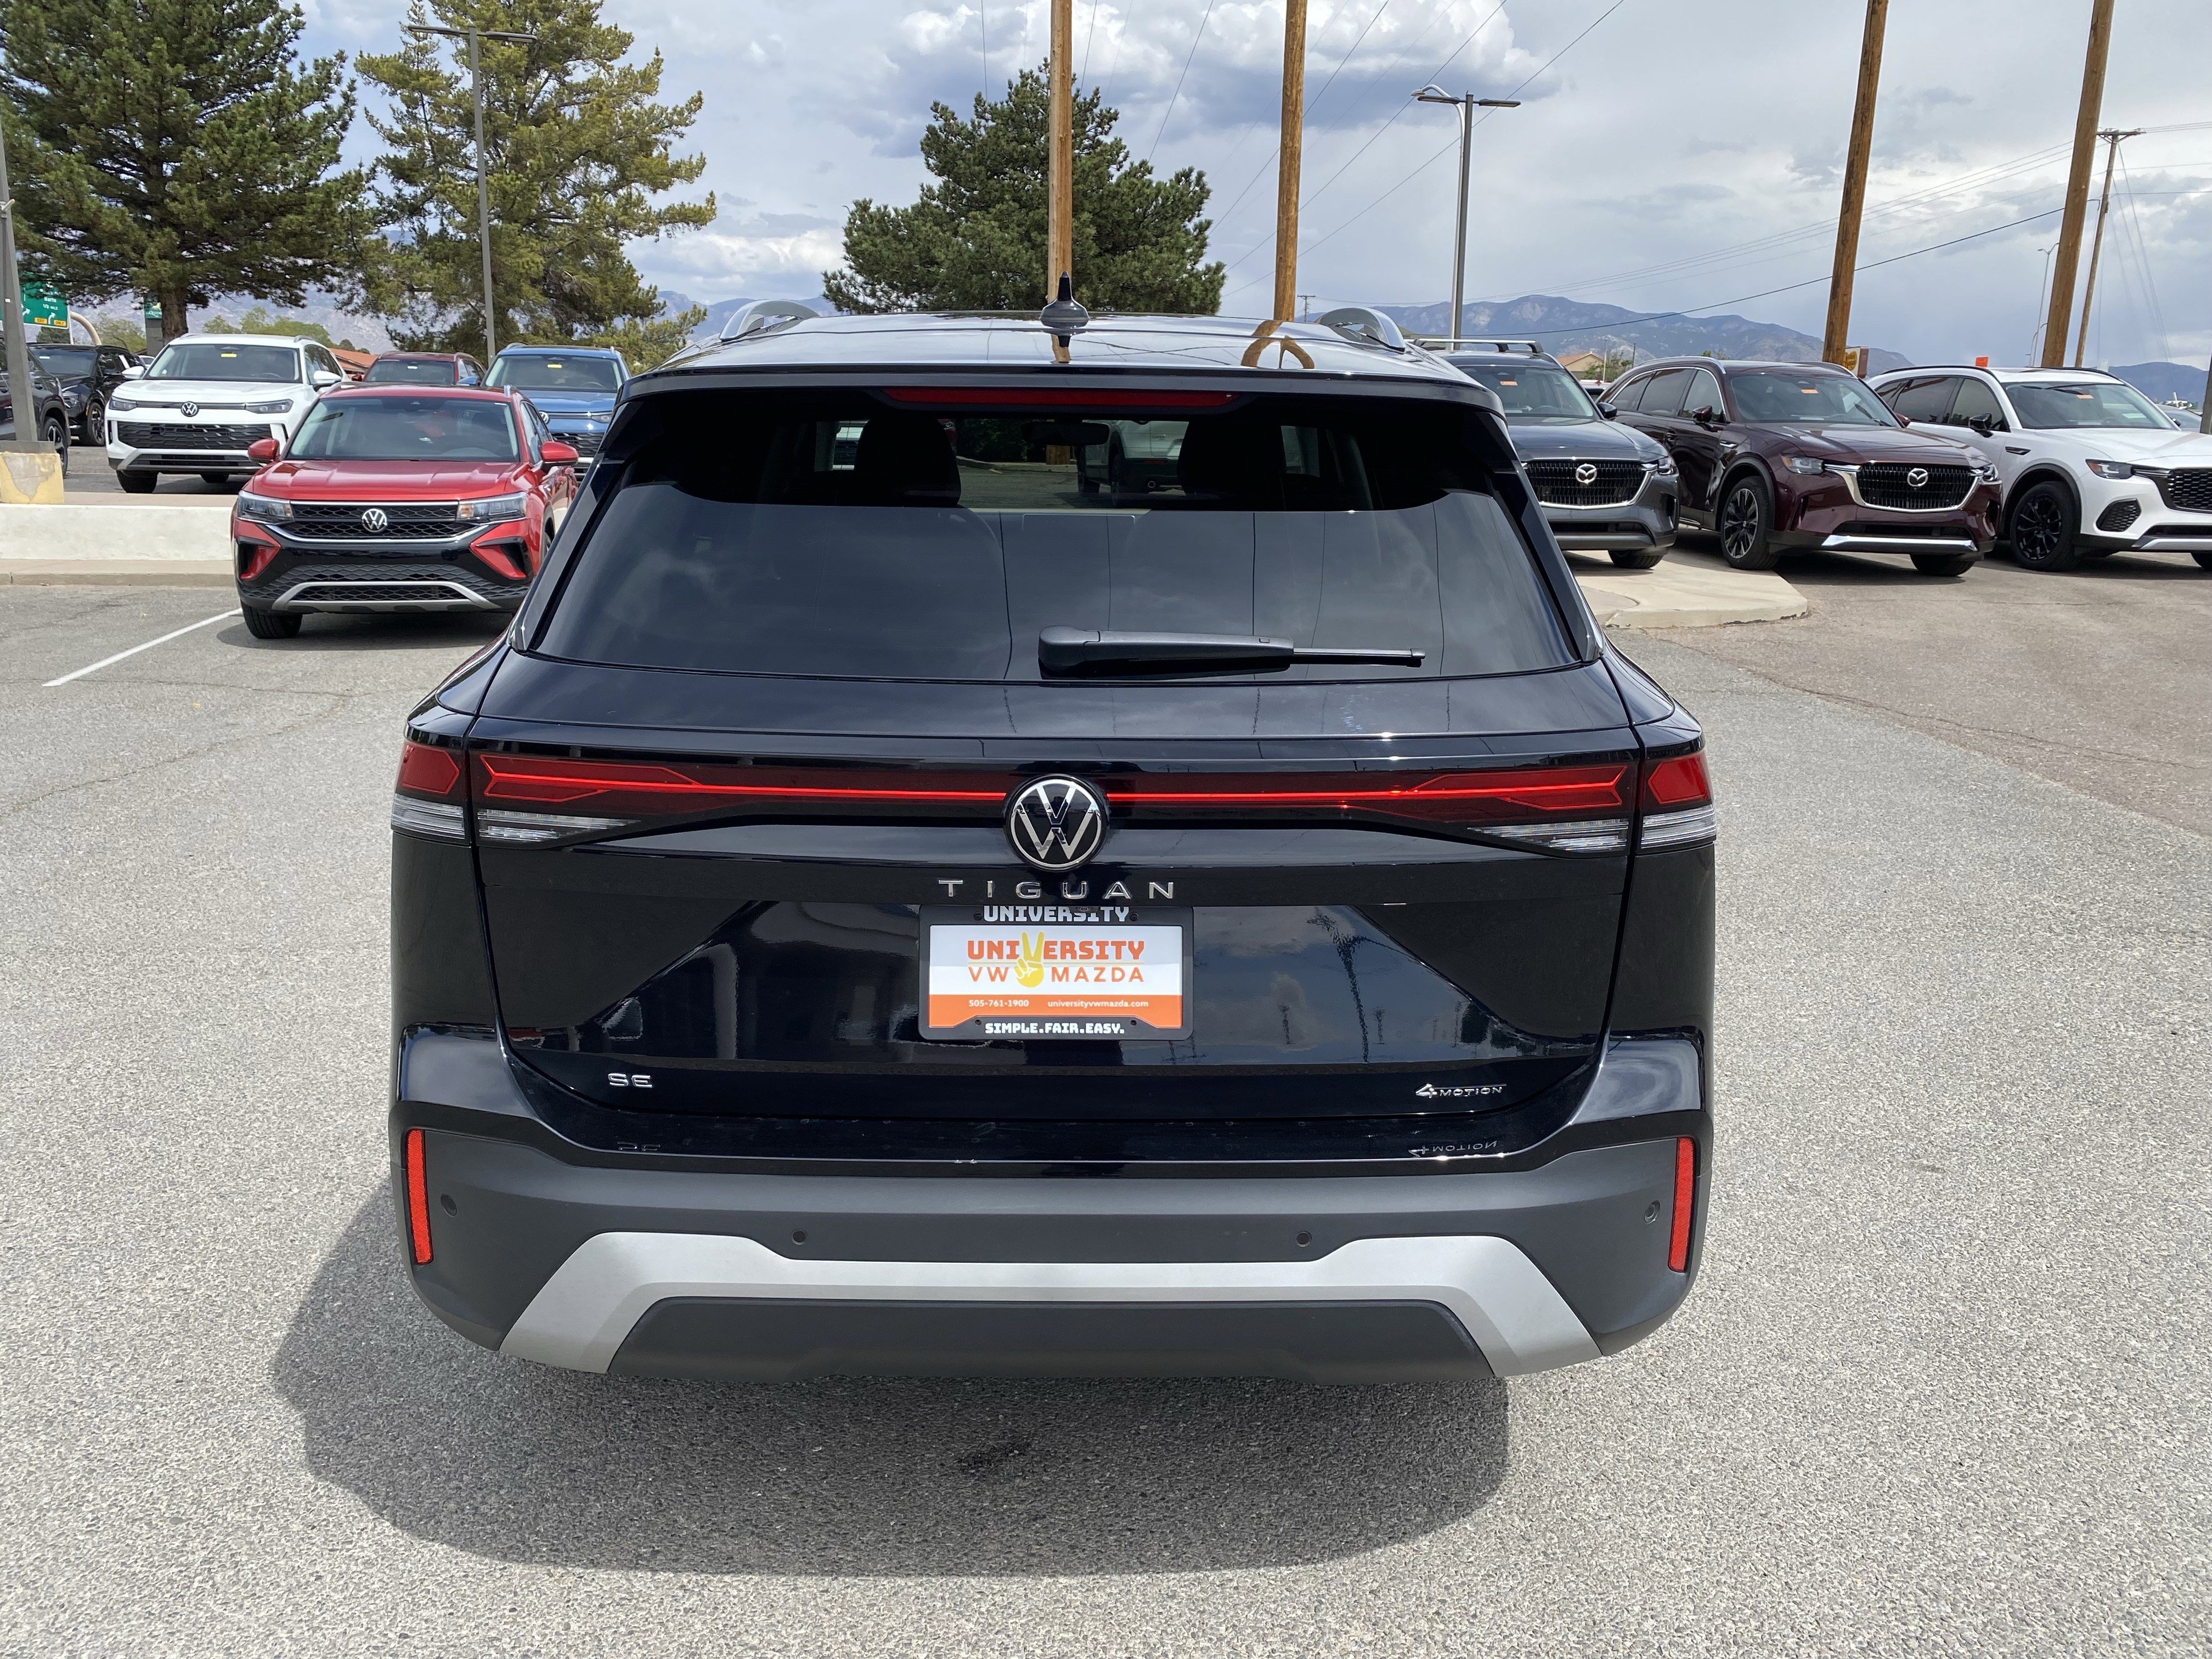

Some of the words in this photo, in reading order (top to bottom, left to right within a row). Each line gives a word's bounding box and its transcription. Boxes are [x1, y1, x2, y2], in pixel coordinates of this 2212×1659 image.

[938, 880, 1173, 900] TIGUAN
[984, 906, 1130, 922] UNIVERSITY
[968, 967, 1009, 982] VW
[1051, 967, 1144, 983] MAZDA
[1047, 1000, 1149, 1009] universityvwmazda.com
[607, 1073, 653, 1088] SE
[1415, 1083, 1503, 1098] 4MOTION
